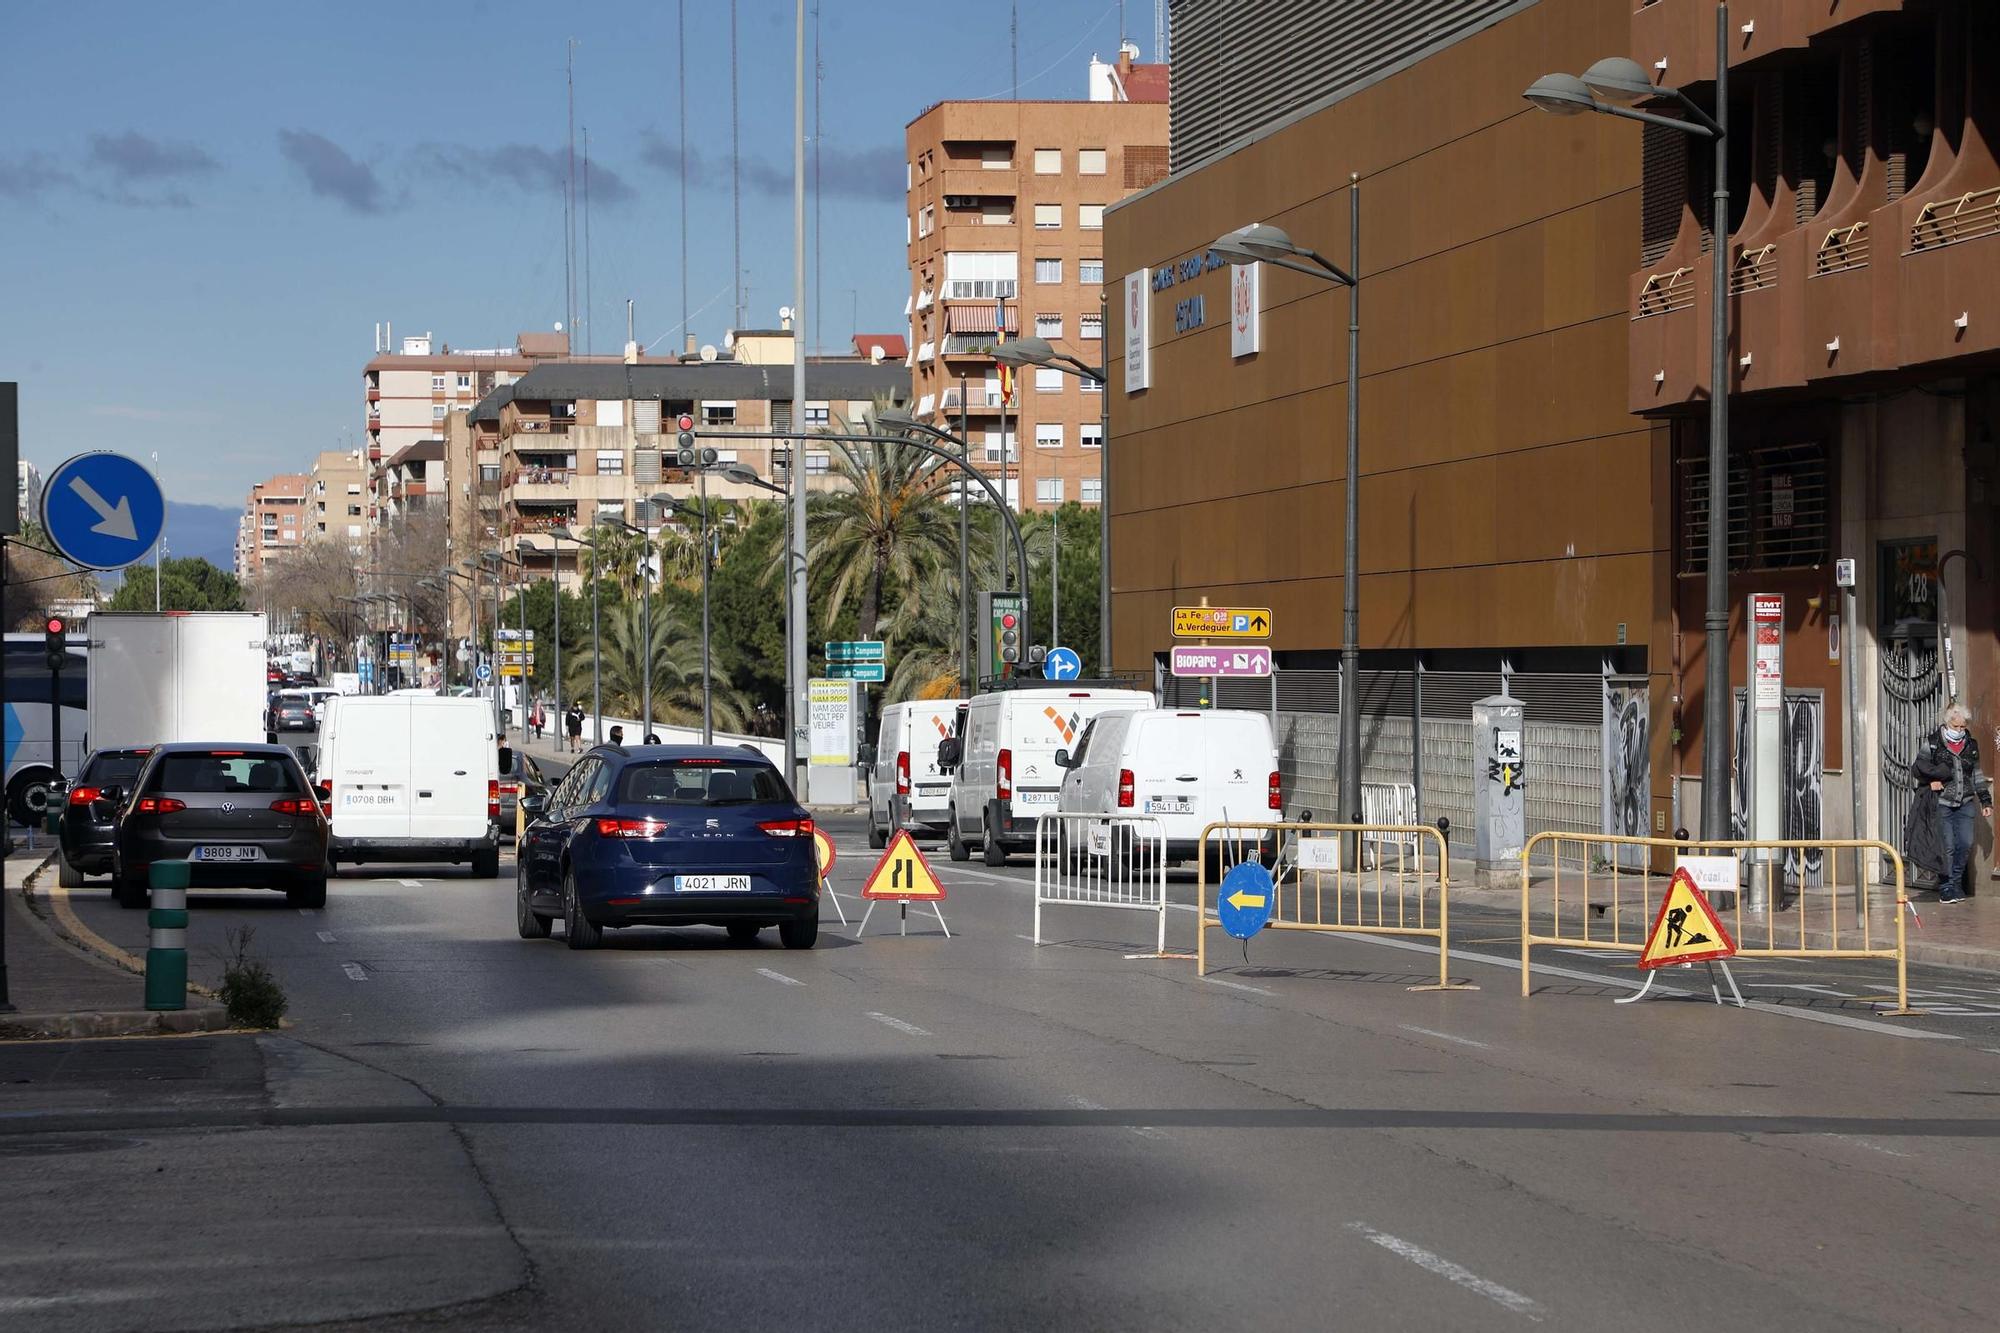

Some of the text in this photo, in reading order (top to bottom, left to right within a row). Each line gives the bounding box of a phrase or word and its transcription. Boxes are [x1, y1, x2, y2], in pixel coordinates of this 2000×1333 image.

[1908, 573, 1928, 603] 128
[830, 704, 848, 712] 2022
[813, 722, 836, 730] VEURE
[1152, 802, 1190, 812] 5941 LPG
[204, 848, 256, 858] 9809 JNW
[685, 877, 748, 890] 4021 JRN
